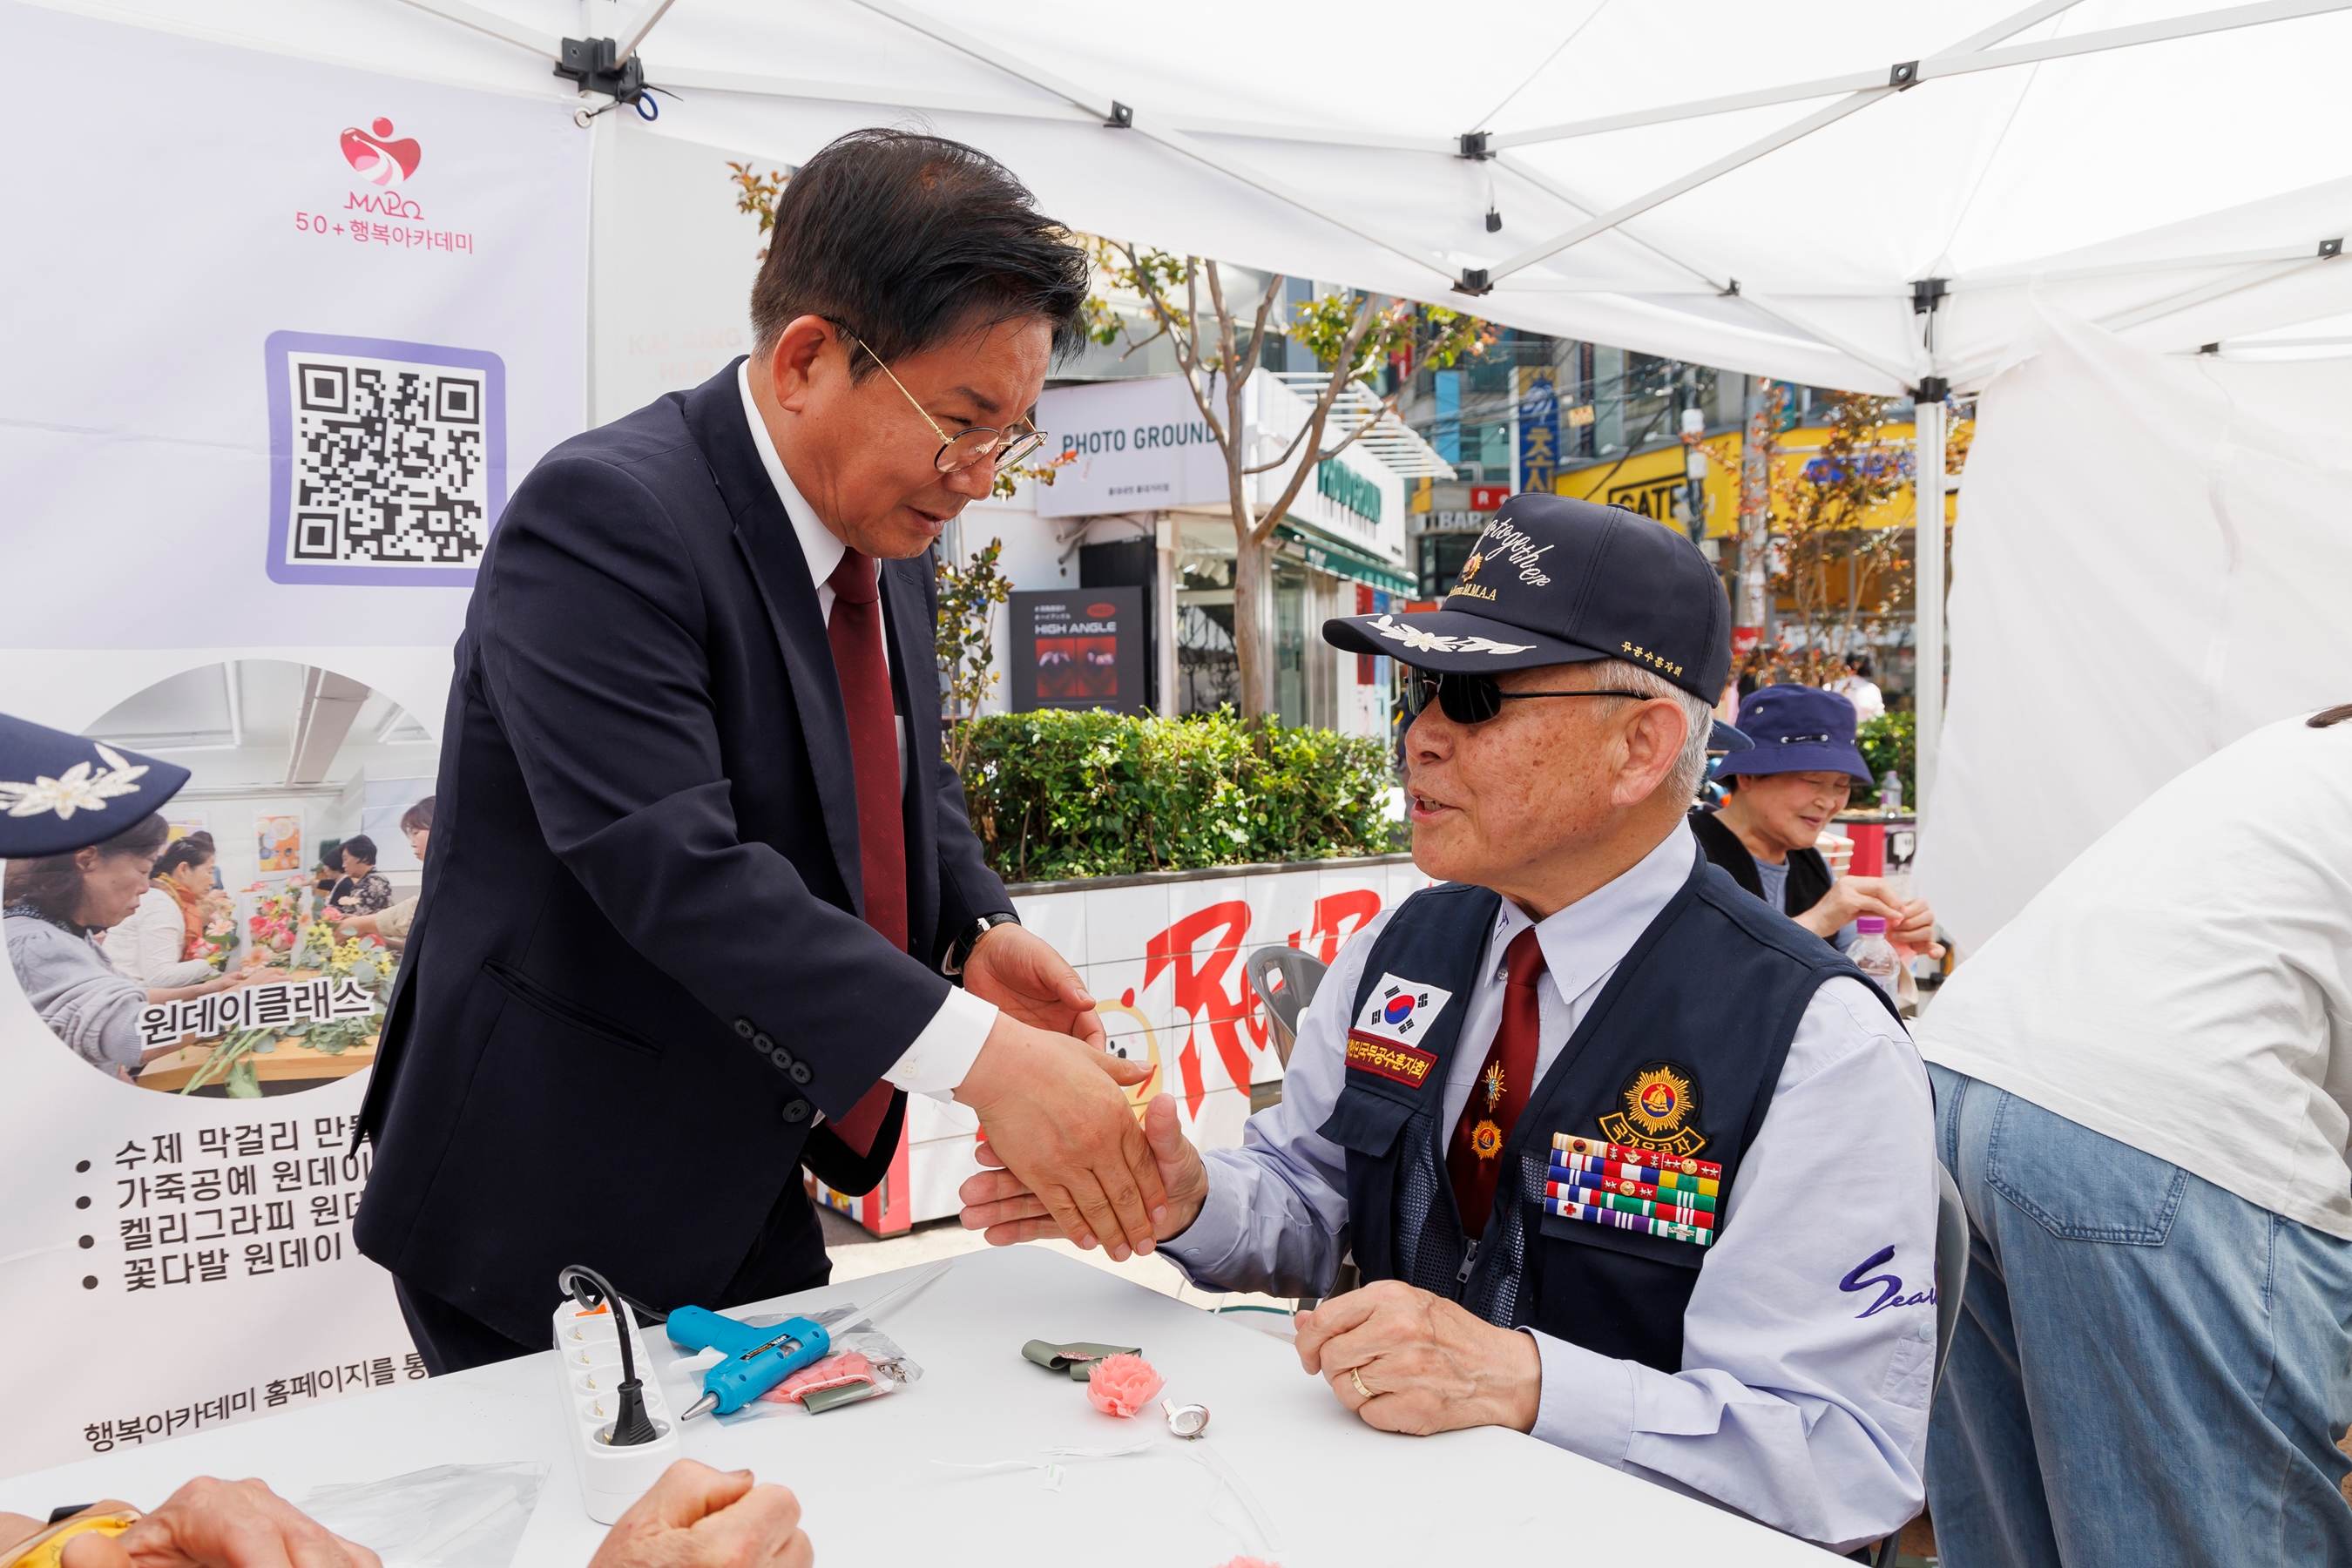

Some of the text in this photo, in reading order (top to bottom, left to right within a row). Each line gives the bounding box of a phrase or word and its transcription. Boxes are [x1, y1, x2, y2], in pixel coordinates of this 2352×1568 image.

[659, 358, 714, 382] HAIR
[1062, 421, 1218, 455] PHOTO GROUND
[1438, 510, 1484, 531] BAR
[1034, 621, 1117, 635] HIGH ANGLE
[139, 979, 371, 1046] 원데이클래스
[115, 1131, 183, 1171] 수제
[198, 1119, 299, 1159] 막걸리
[117, 1151, 369, 1210] 가죽공예 원데이
[120, 1200, 294, 1252] 켈리그라피
[124, 1231, 341, 1293] 꽃다발 원데이
[84, 1386, 256, 1453] 행복아카데미
[263, 1355, 396, 1409] 홈페이지를
